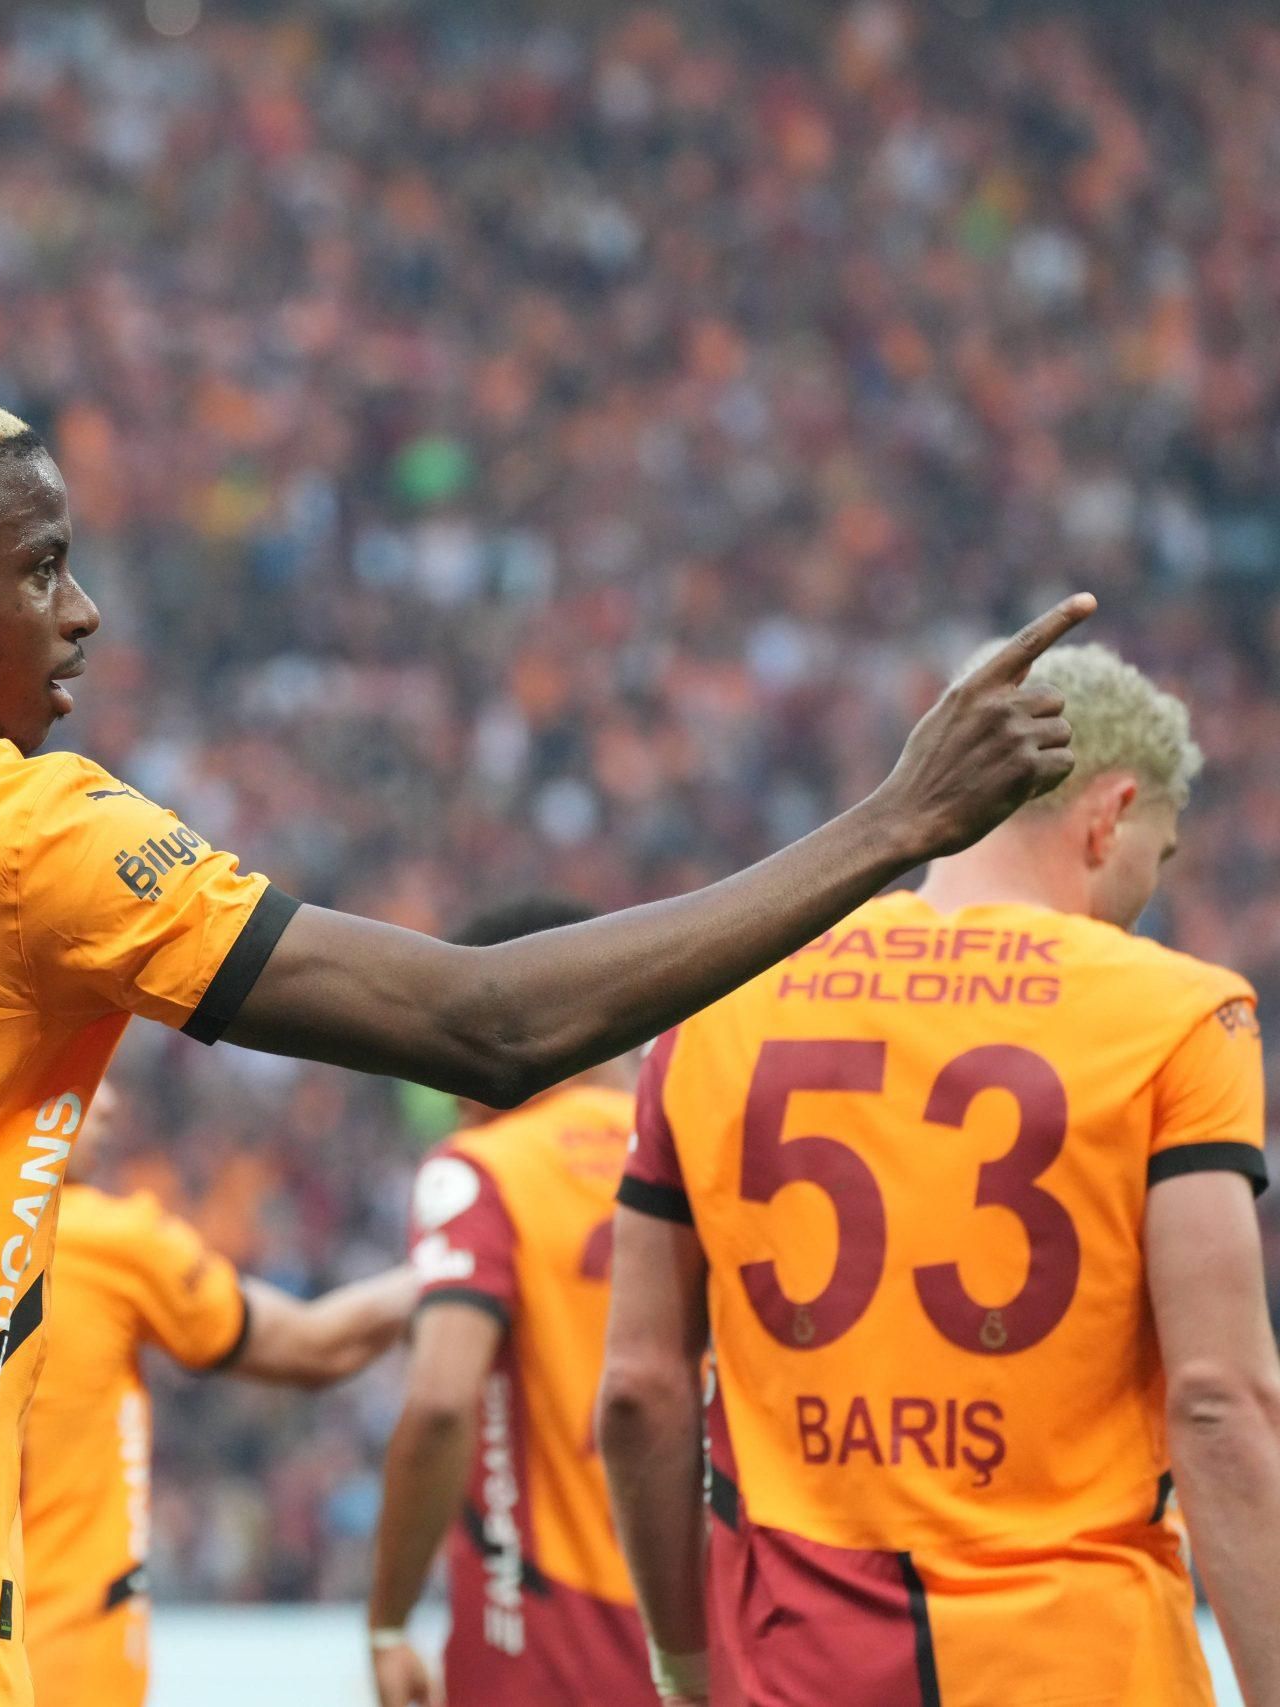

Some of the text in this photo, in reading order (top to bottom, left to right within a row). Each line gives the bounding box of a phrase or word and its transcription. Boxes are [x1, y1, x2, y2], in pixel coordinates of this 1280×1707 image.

[114, 827, 205, 902] Bilyo
[739, 1039, 1080, 1357] 53
[796, 1394, 1007, 1488] BARIŞ
